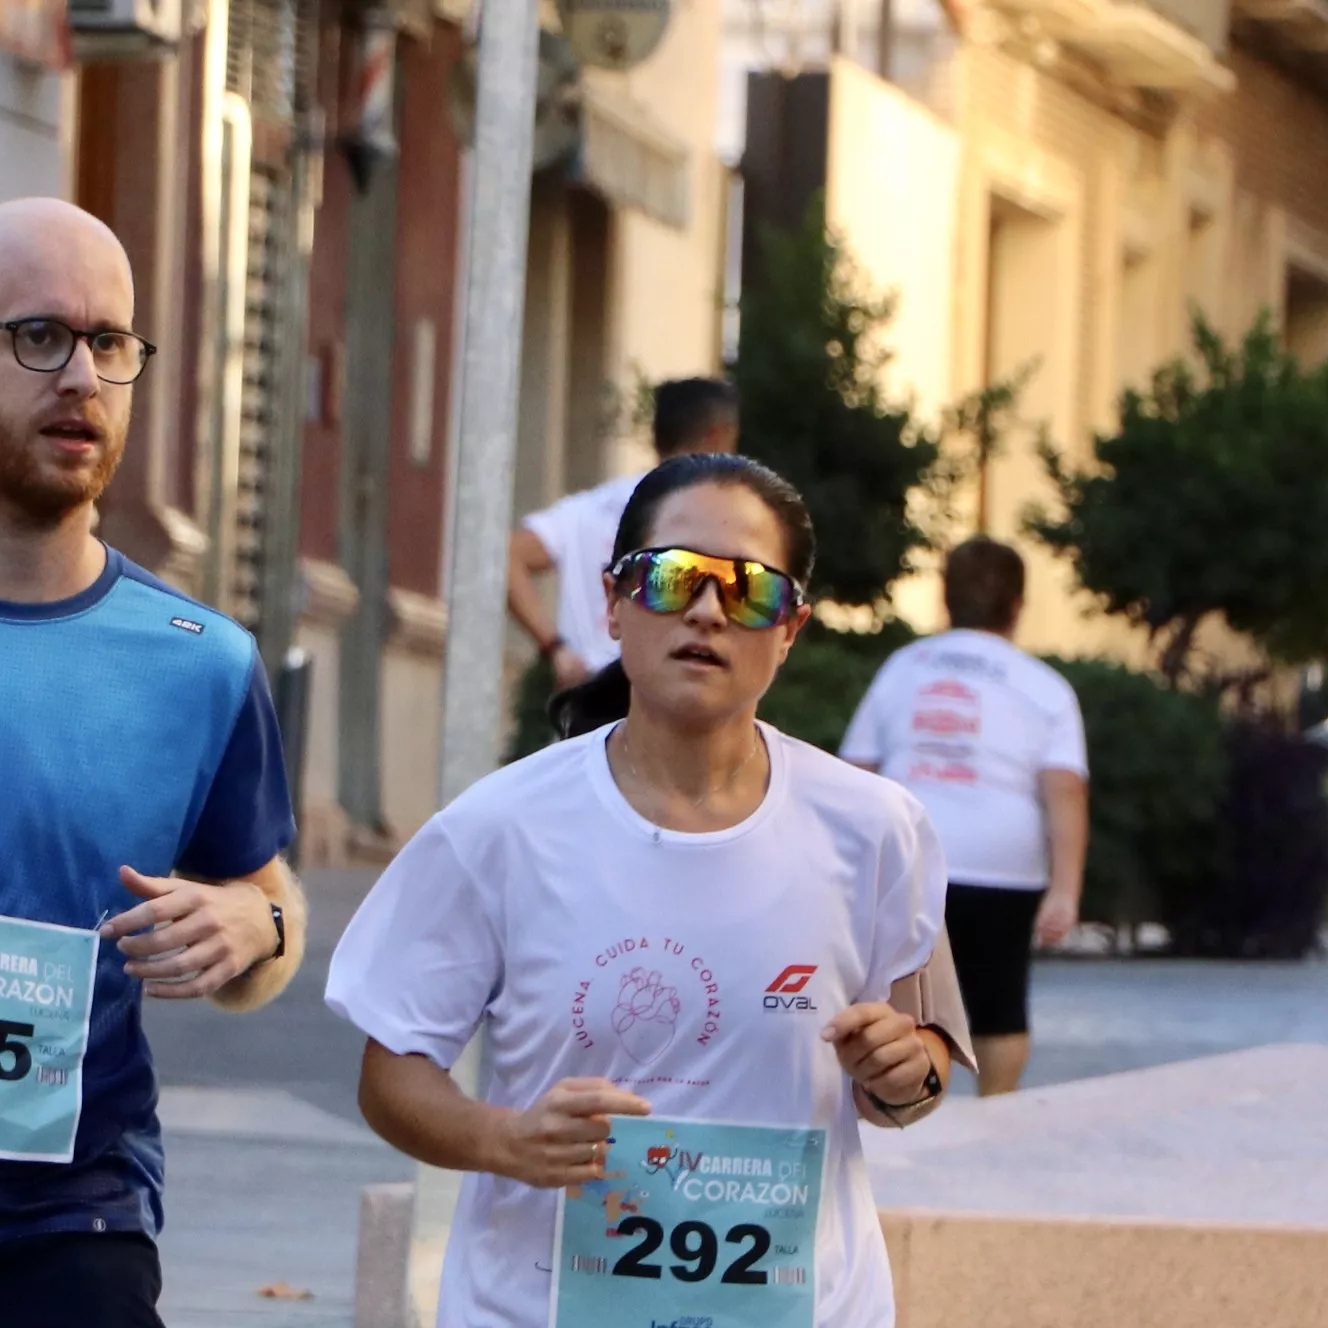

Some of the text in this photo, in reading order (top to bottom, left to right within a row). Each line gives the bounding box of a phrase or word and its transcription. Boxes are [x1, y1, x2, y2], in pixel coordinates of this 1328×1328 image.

[573, 980, 594, 1049] LUCENA
[595, 937, 649, 967] CUIDA
[664, 937, 684, 955] TU
[700, 1154, 772, 1177] CARRERA
[612, 1216, 771, 1285] 292
